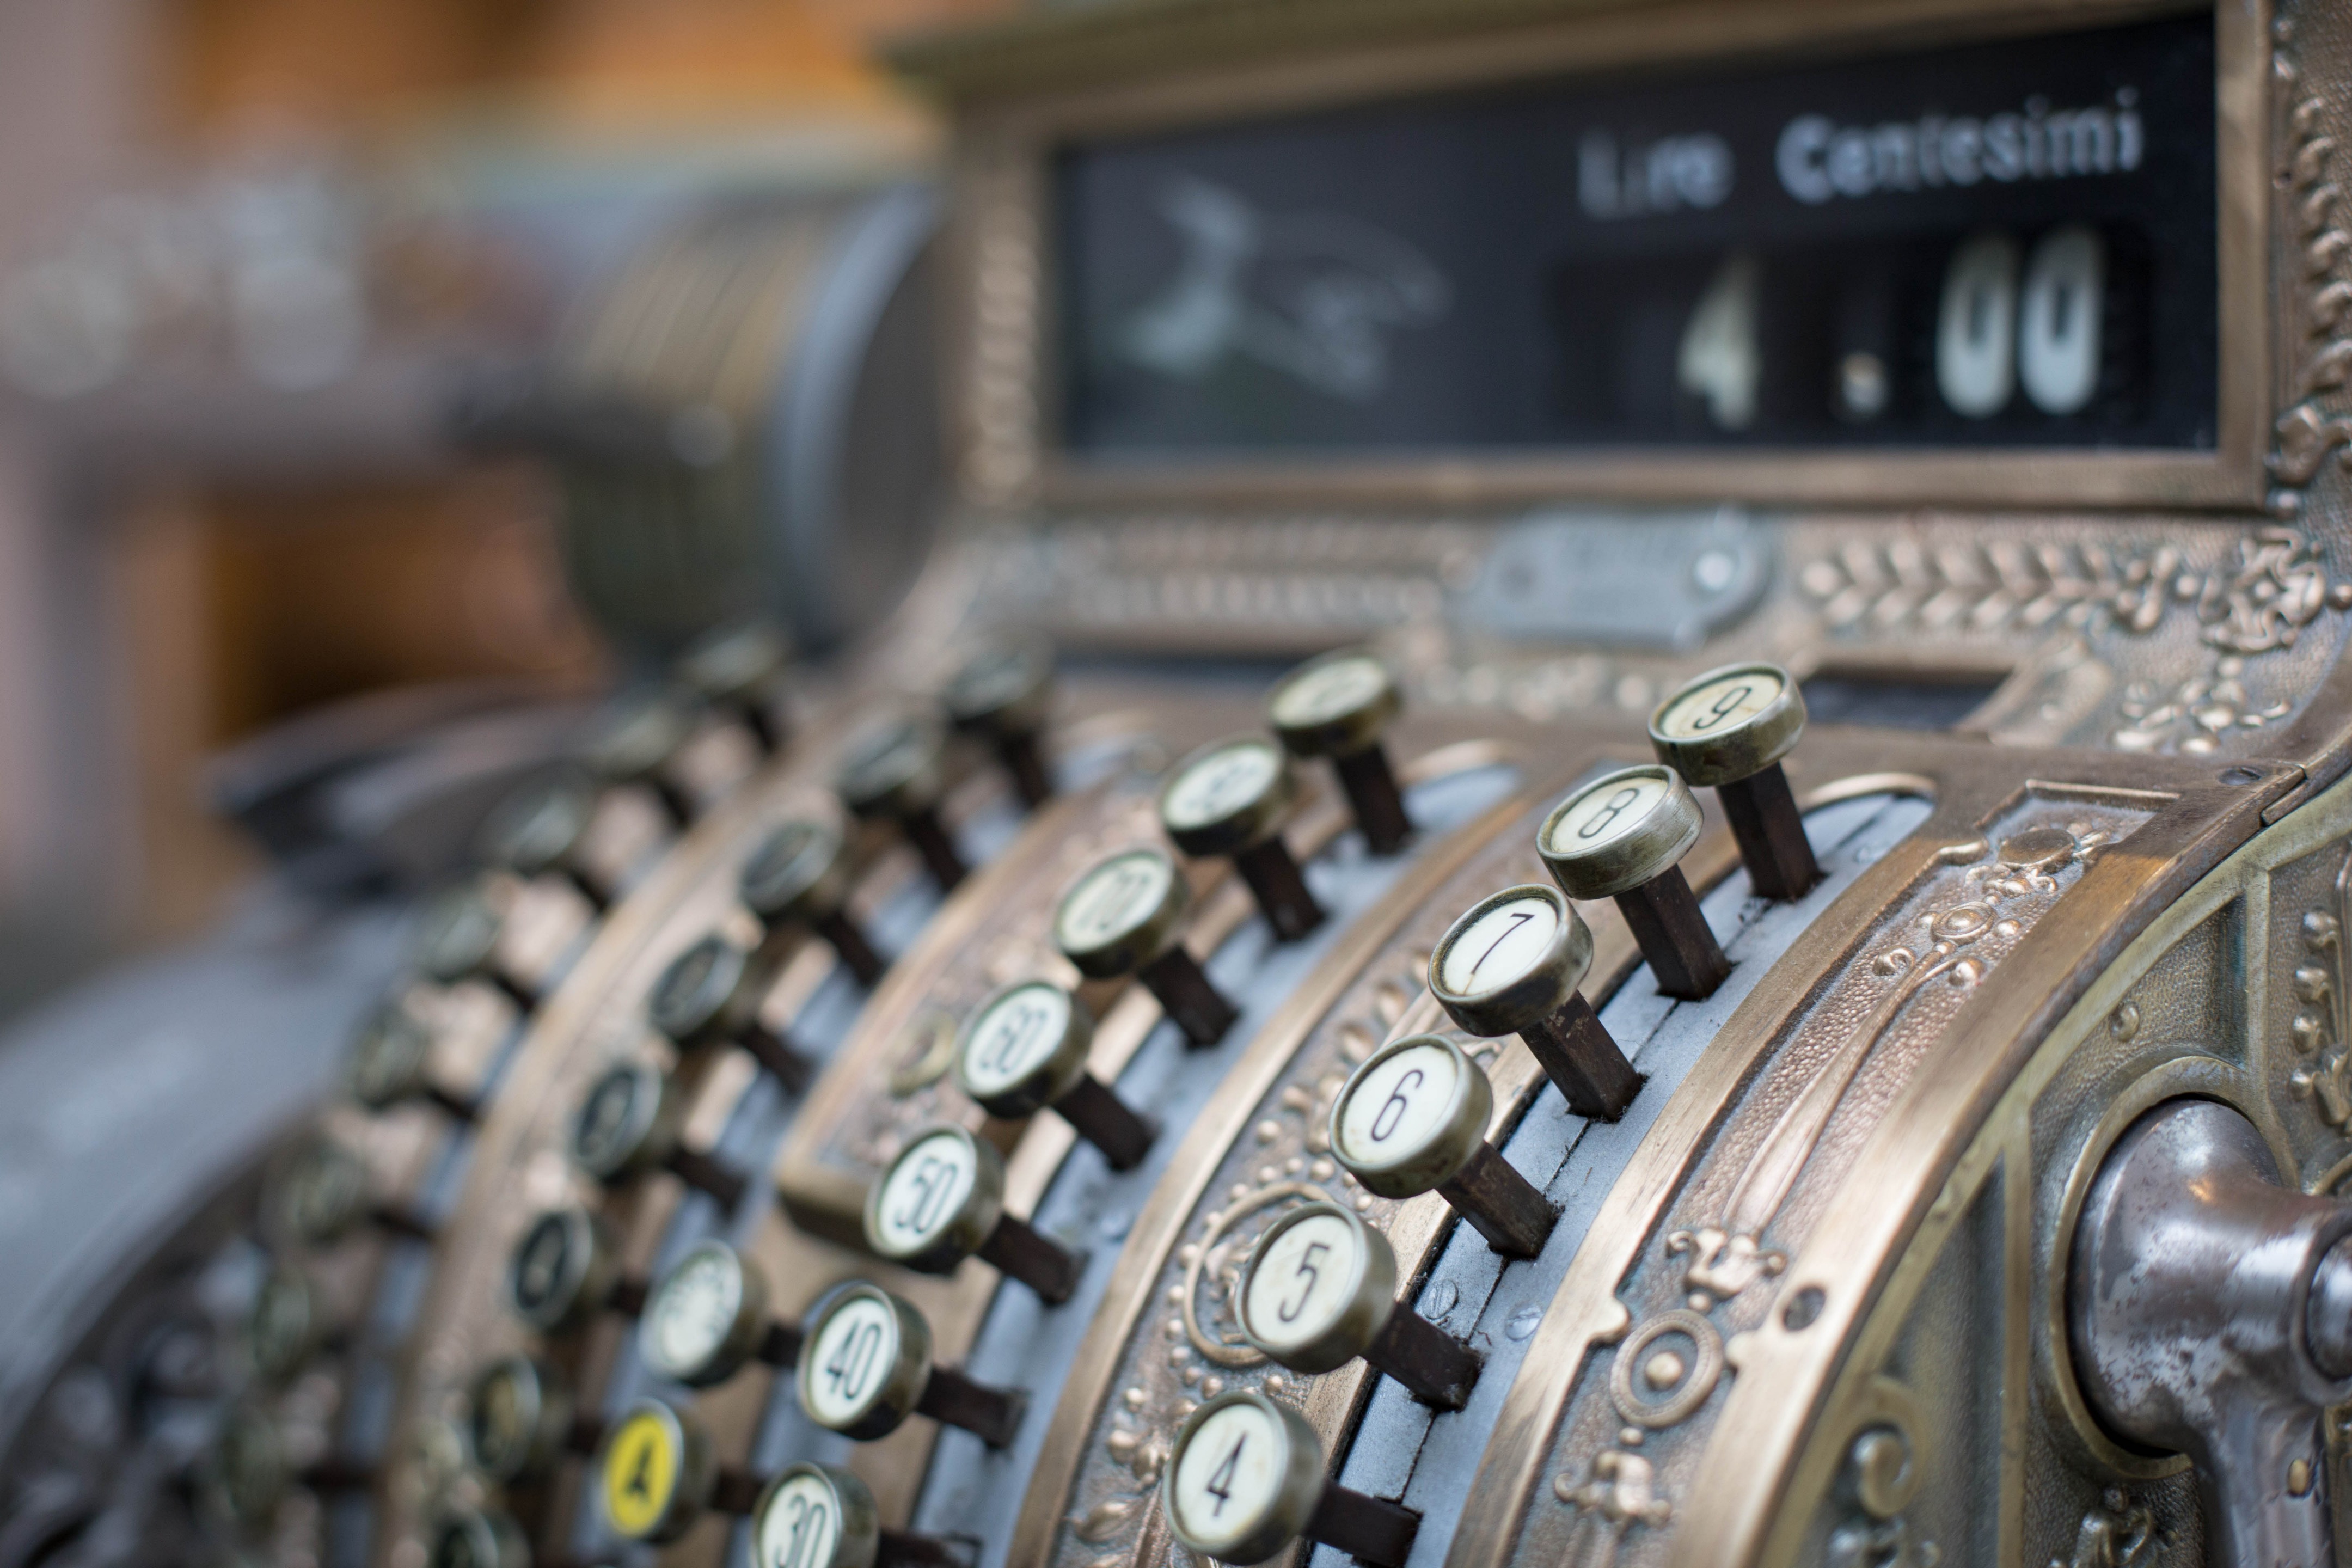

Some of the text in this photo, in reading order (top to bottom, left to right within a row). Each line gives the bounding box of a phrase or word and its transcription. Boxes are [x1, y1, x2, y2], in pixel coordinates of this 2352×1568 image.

[1776, 85, 2143, 204] Centesimi
[1693, 686, 1751, 730] 9
[1578, 788, 1639, 838] 8
[1465, 912, 1535, 995] 7
[1371, 1069, 1424, 1142] 6
[896, 1156, 958, 1235] 50
[1279, 1241, 1330, 1322] 5
[827, 1316, 881, 1400] 40
[1207, 1431, 1247, 1517] 4
[774, 1493, 826, 1568] 30
